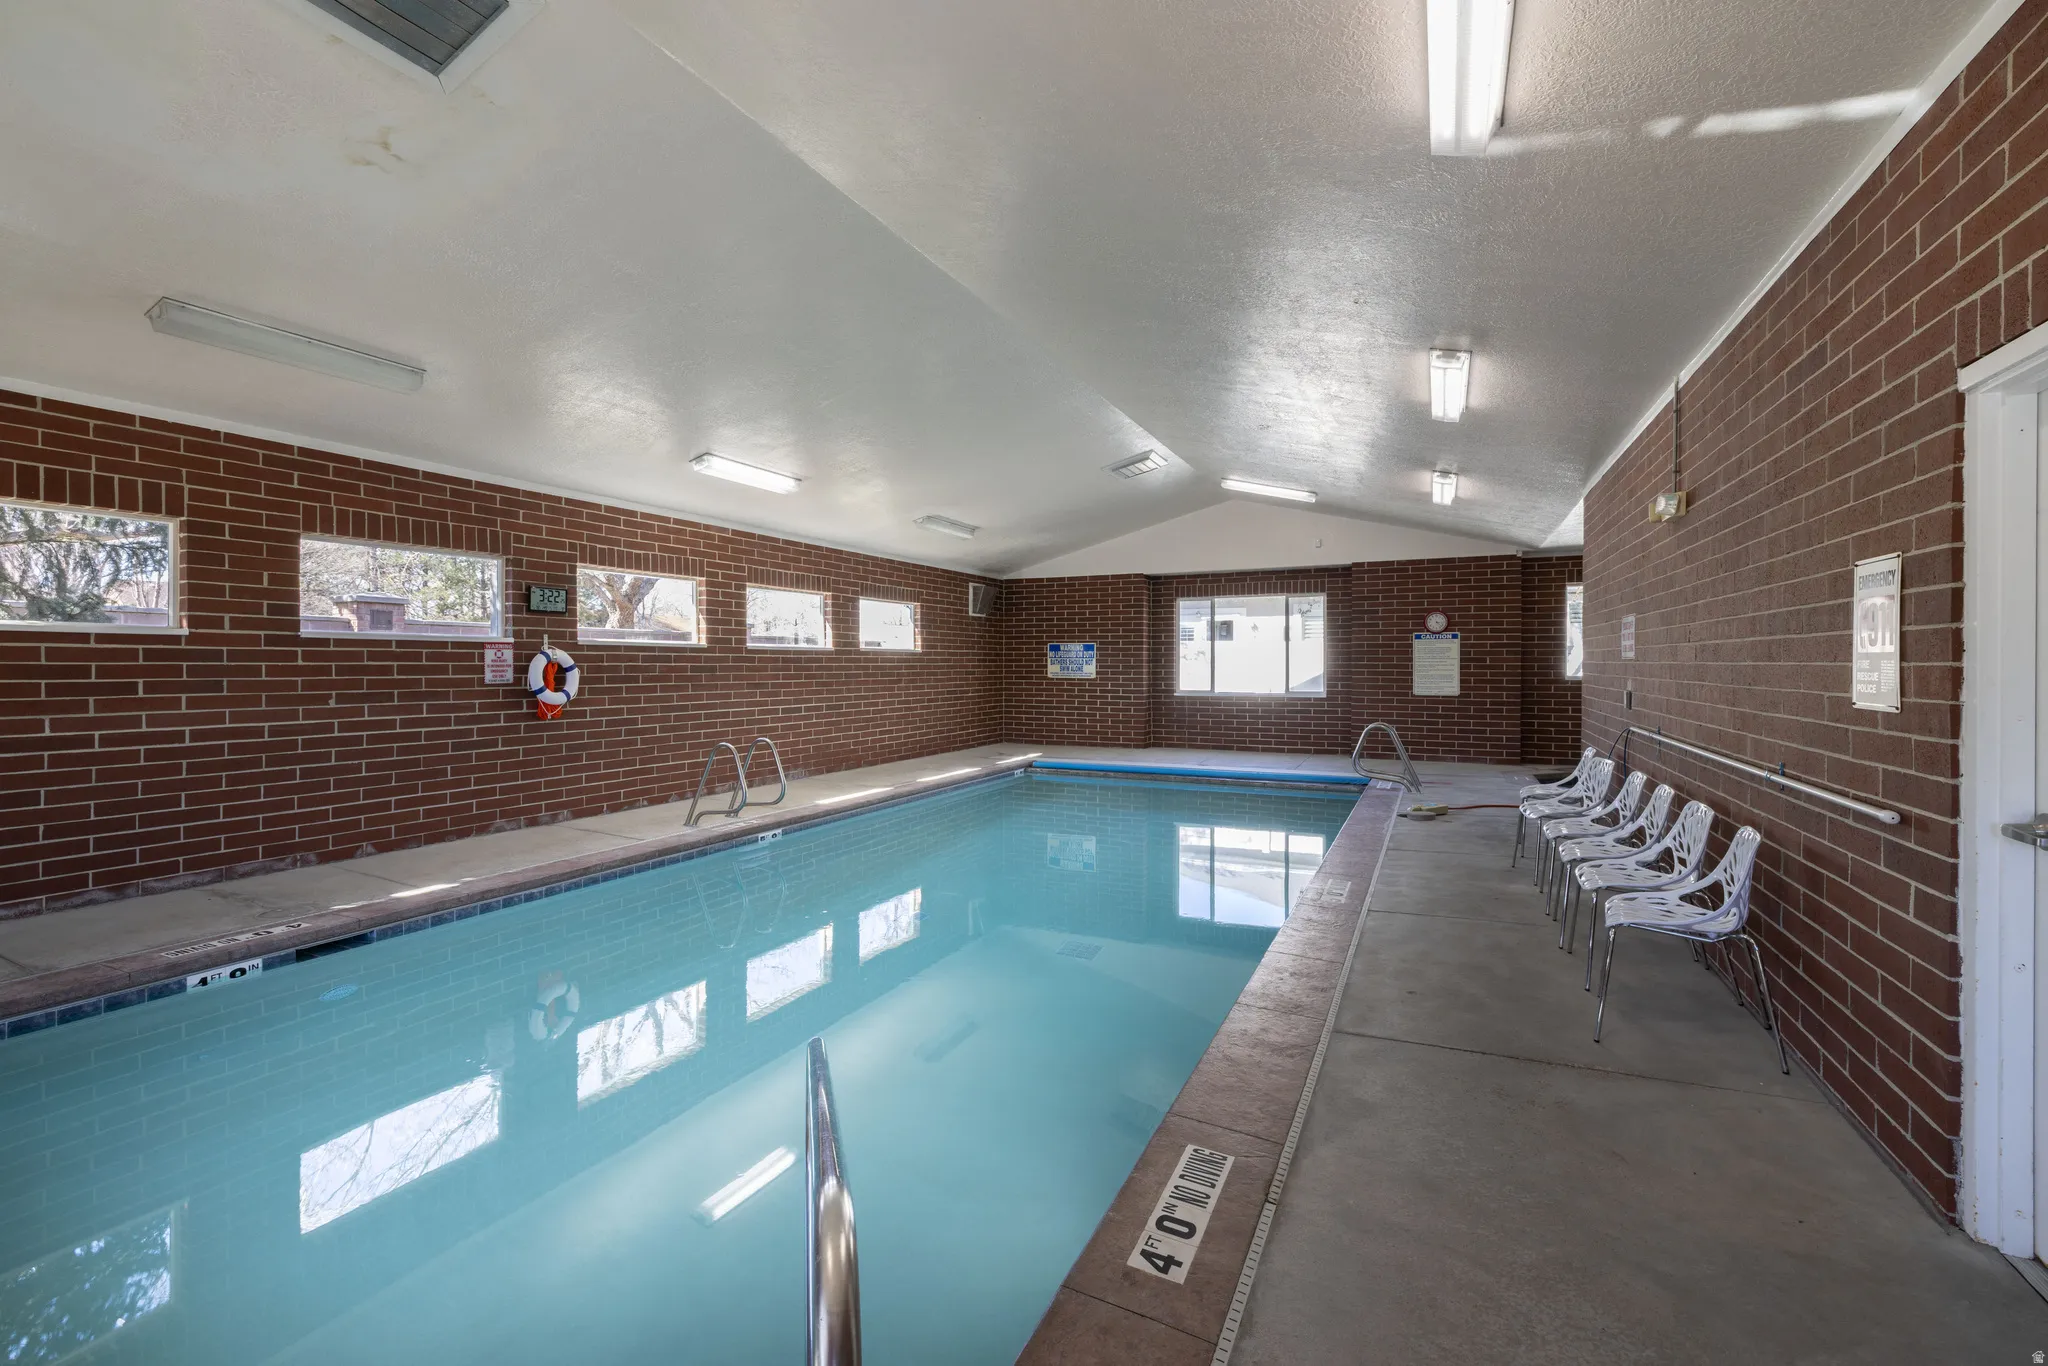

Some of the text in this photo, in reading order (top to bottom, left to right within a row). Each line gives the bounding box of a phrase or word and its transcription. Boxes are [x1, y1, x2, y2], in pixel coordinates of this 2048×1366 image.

[1858, 568, 1897, 591] EMERGENCY
[539, 589, 560, 603] 3:22
[1867, 601, 1895, 649] 911
[1857, 659, 1871, 669] FIRE
[1856, 671, 1879, 681] RESCUE
[1856, 683, 1877, 693] POLICE
[165, 943, 216, 957] DIVING
[191, 962, 260, 988] 4 FT 0 IN
[1168, 1147, 1228, 1209] NO DIVING
[1139, 1201, 1197, 1275] 4 FT 0 IN
